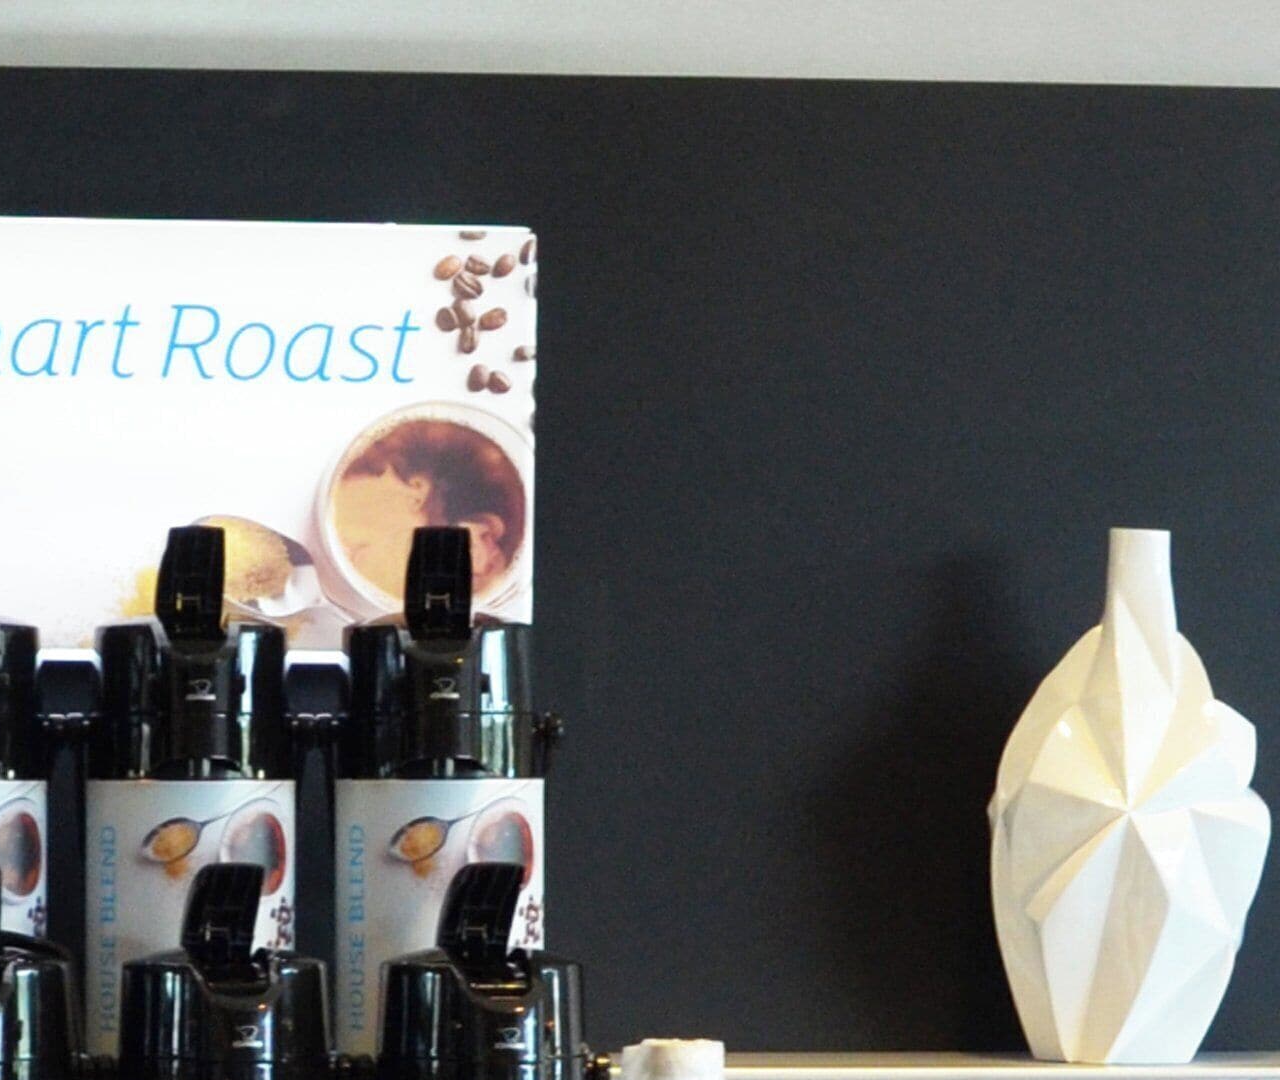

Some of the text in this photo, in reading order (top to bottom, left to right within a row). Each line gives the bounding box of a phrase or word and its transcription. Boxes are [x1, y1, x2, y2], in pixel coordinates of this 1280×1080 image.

[161, 303, 421, 384] Roast
[99, 825, 116, 1032] HOUSE BLEND
[348, 823, 365, 1031] HOUSE BLEND
